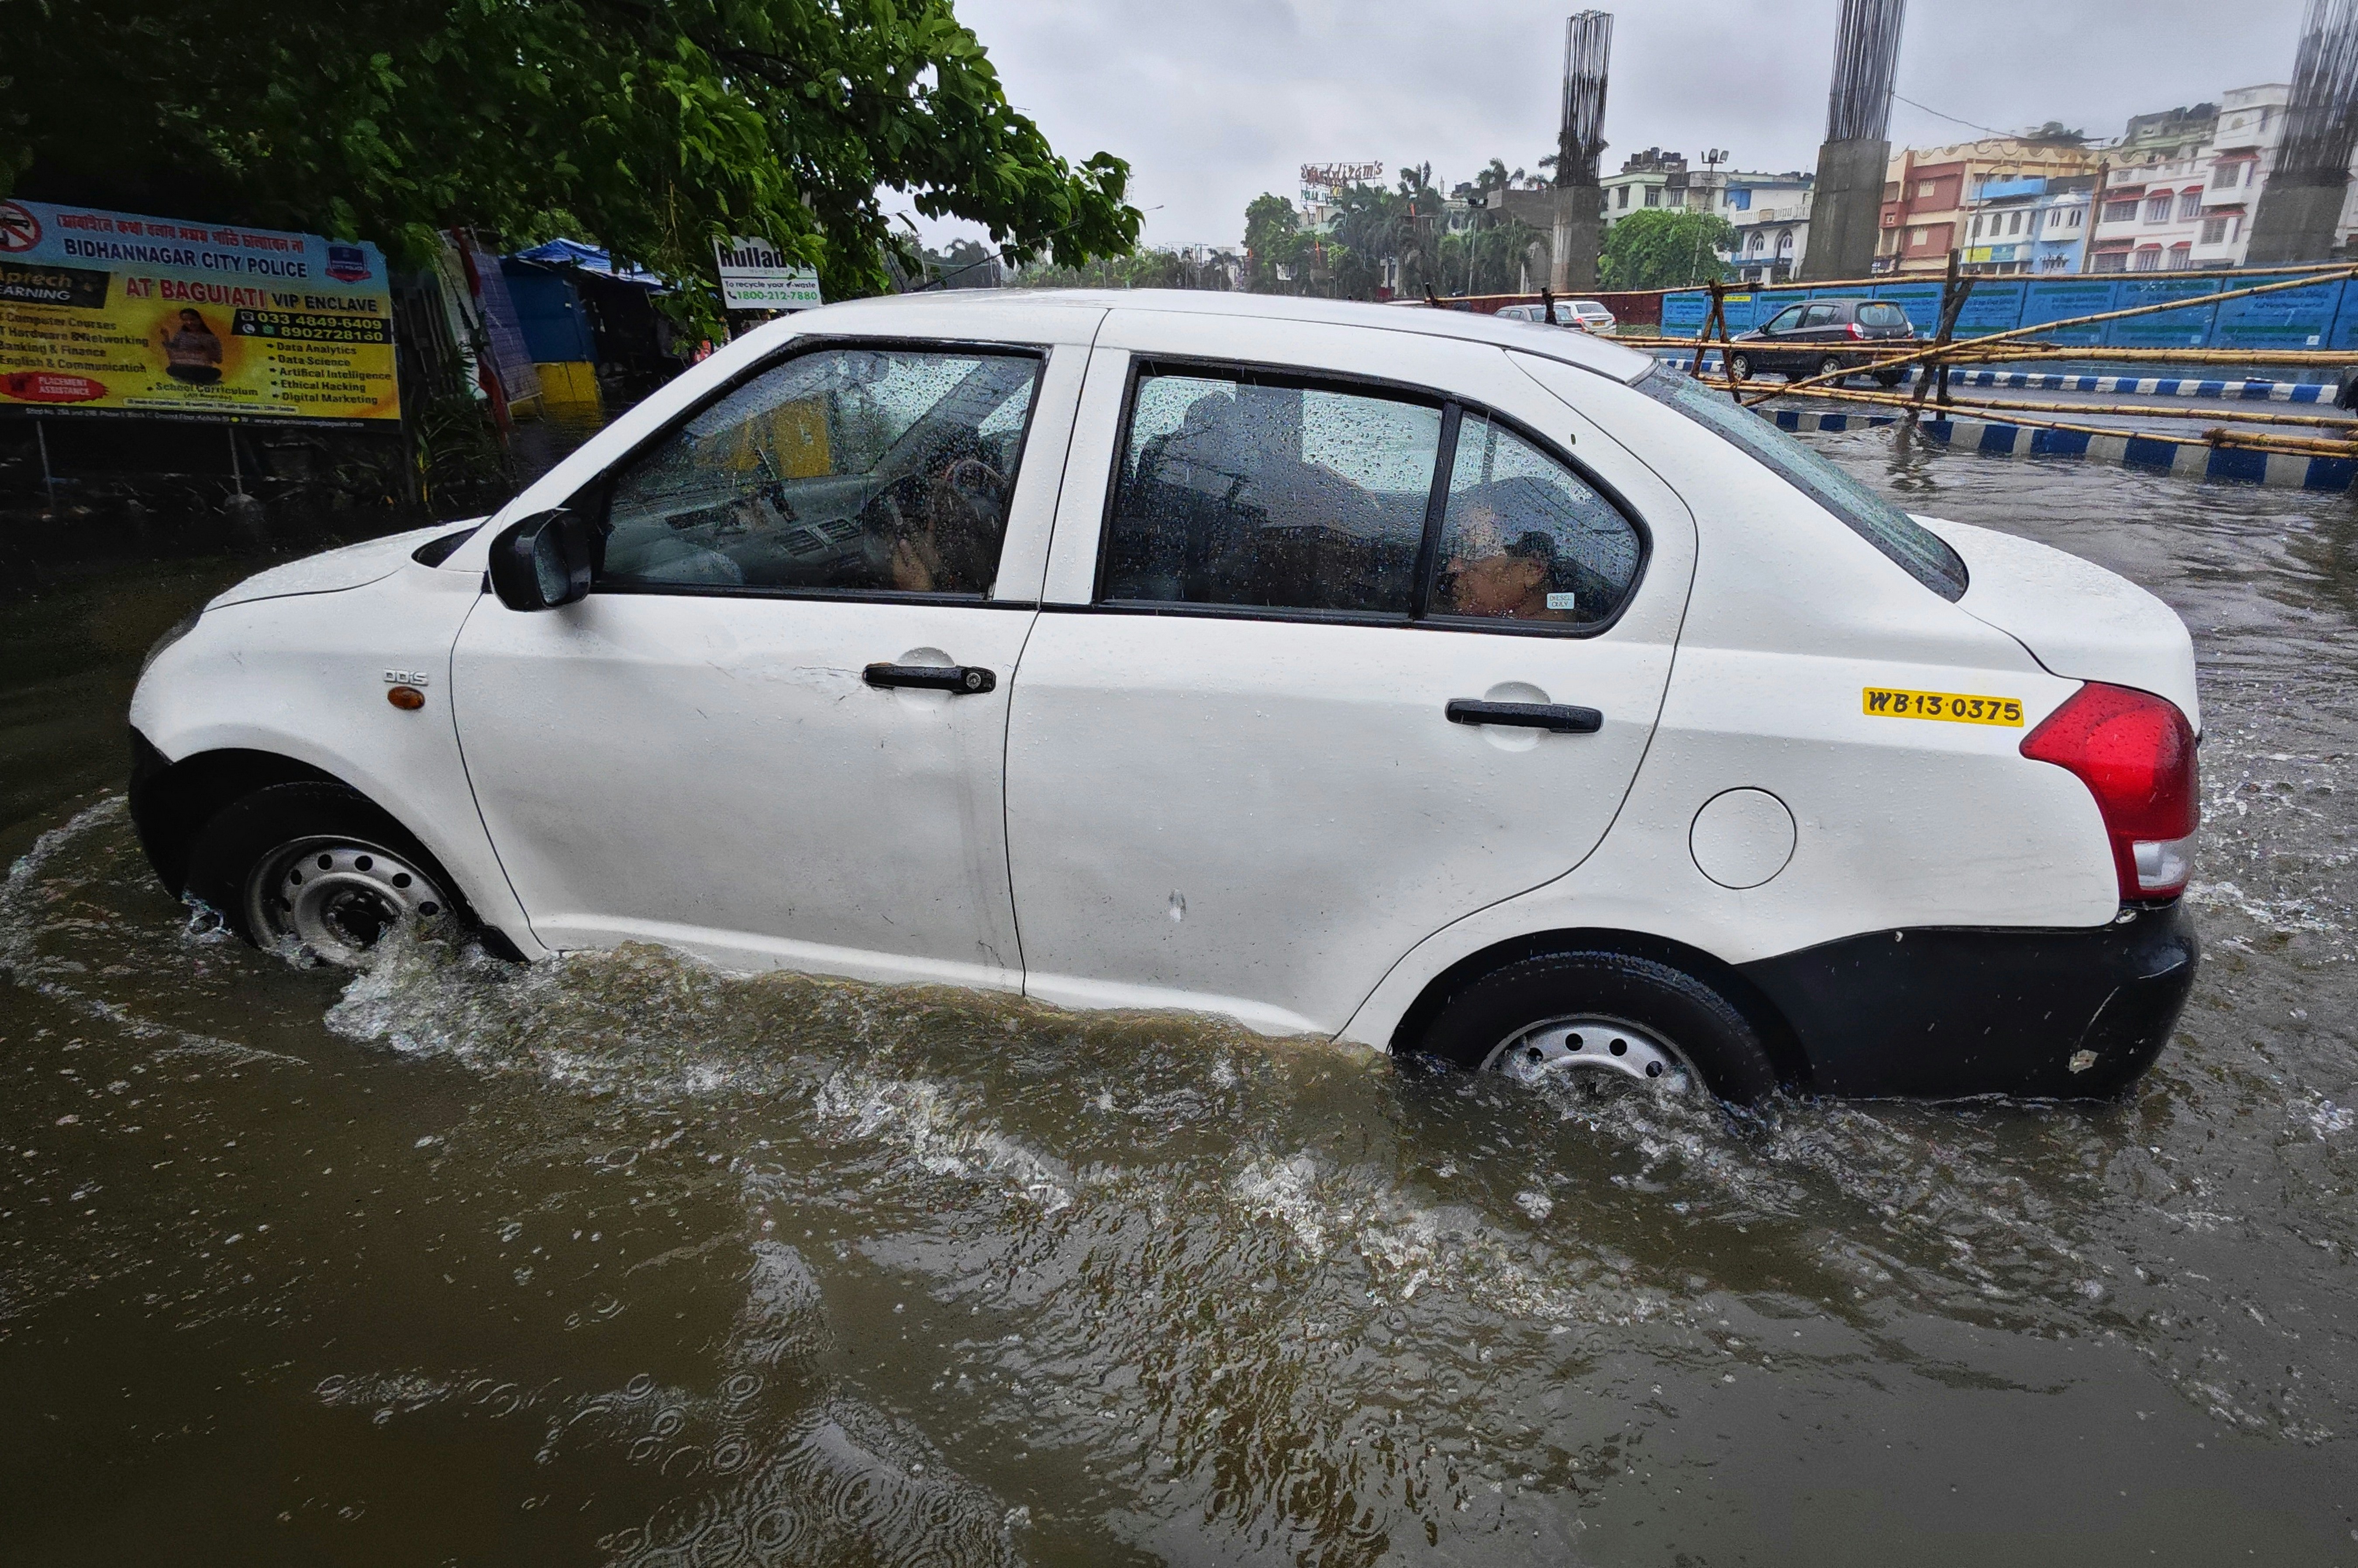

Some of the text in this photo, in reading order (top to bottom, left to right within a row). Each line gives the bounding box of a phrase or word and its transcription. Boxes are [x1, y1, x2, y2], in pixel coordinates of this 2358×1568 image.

[63, 238, 307, 278] BIDHANNAGAR CITY POLICE
[125, 277, 377, 311] AT BAGUIATI VIP ENCLAVE
[69, 318, 117, 330] Courses
[257, 312, 383, 330] 033 4849-6409
[276, 342, 357, 355] Data Analytics
[278, 355, 351, 366] Data Science
[327, 370, 391, 381] Intelligence
[281, 379, 366, 393] Ethical Hacking
[282, 392, 378, 405] Digital Marketing
